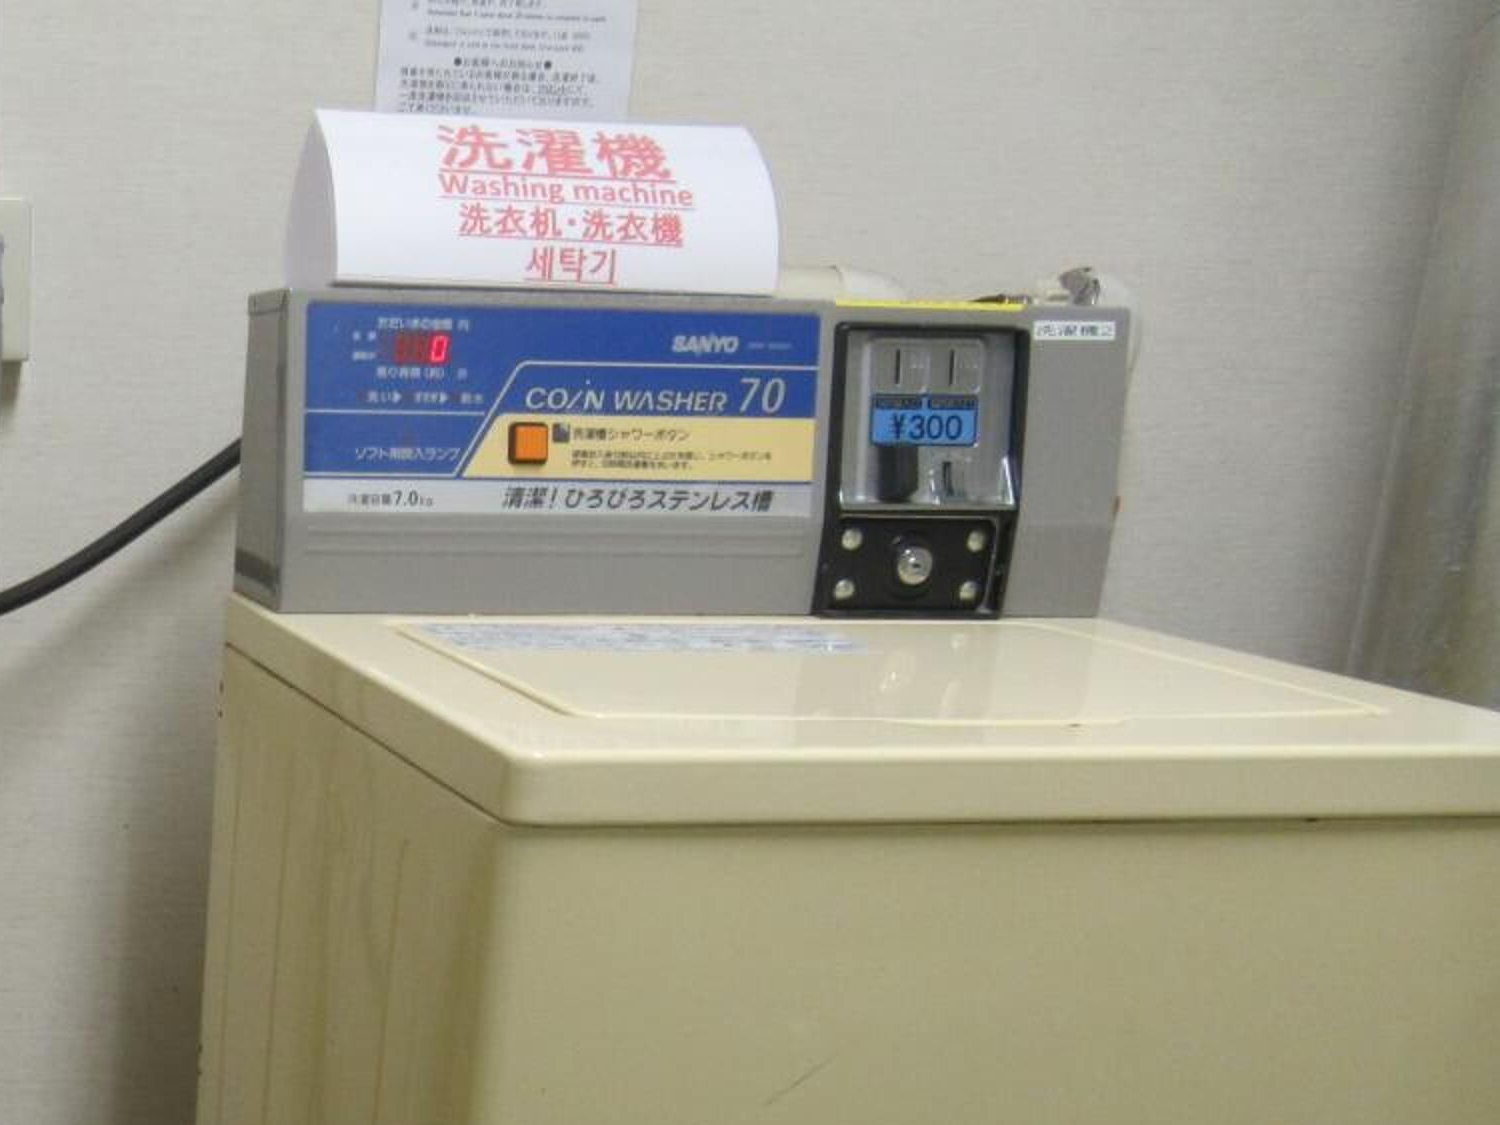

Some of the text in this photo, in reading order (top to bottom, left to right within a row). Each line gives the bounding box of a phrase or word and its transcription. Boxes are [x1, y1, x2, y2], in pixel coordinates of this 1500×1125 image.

[437, 124, 676, 180] 洗濯機
[438, 174, 693, 207] Washing machine
[525, 246, 617, 284] 세탁기
[430, 335, 449, 364] 0
[672, 335, 739, 357] SANYO
[614, 389, 729, 414] WASHER
[739, 377, 788, 415] 70
[890, 413, 964, 441] ¥300
